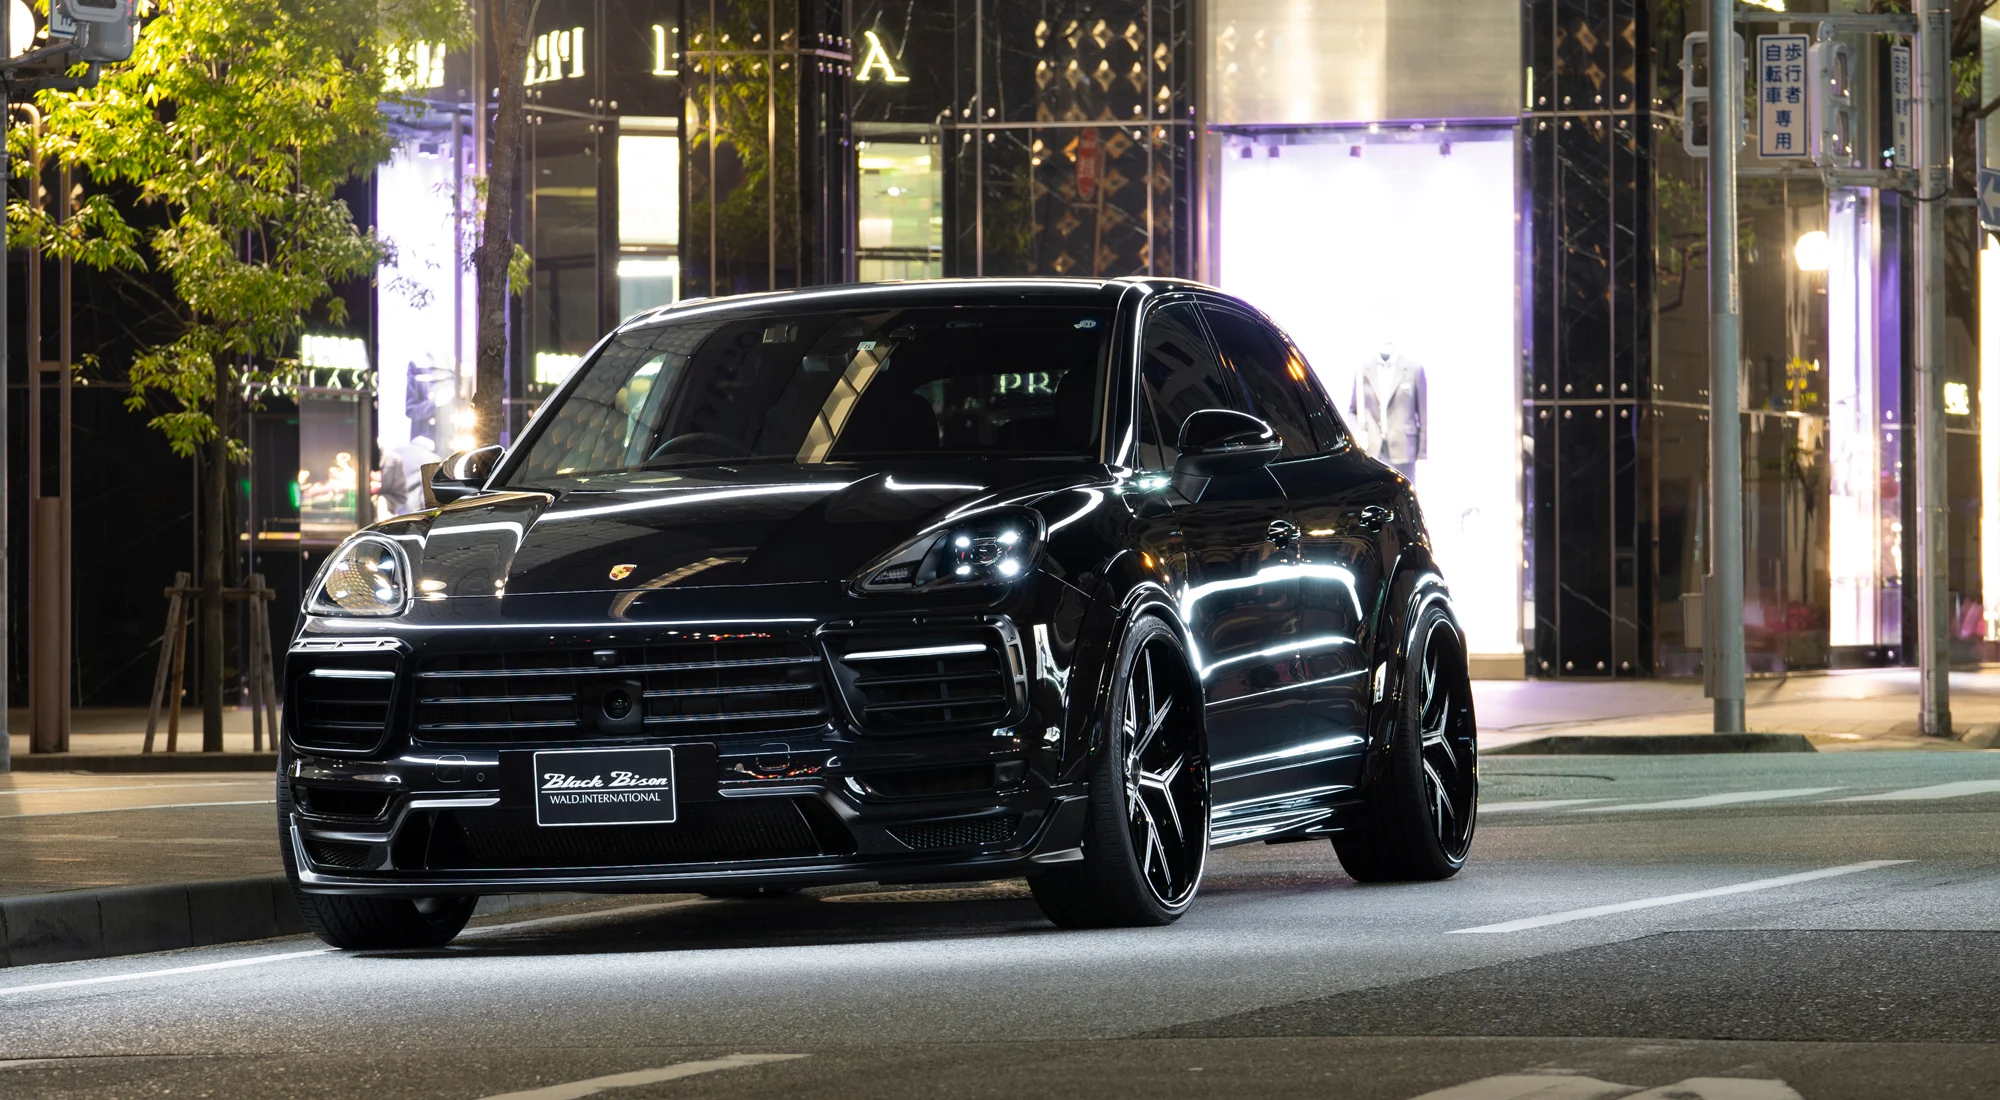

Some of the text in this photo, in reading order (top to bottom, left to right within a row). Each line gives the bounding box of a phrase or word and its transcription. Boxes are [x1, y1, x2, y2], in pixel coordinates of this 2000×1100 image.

[1765, 43, 1782, 104] 自転車
[1784, 43, 1802, 104] 歩行者
[1775, 109, 1792, 150] 専用
[999, 371, 1061, 395] PR
[541, 770, 669, 789] Black Bison
[550, 792, 661, 804] WALD.INTERNATIONAL
